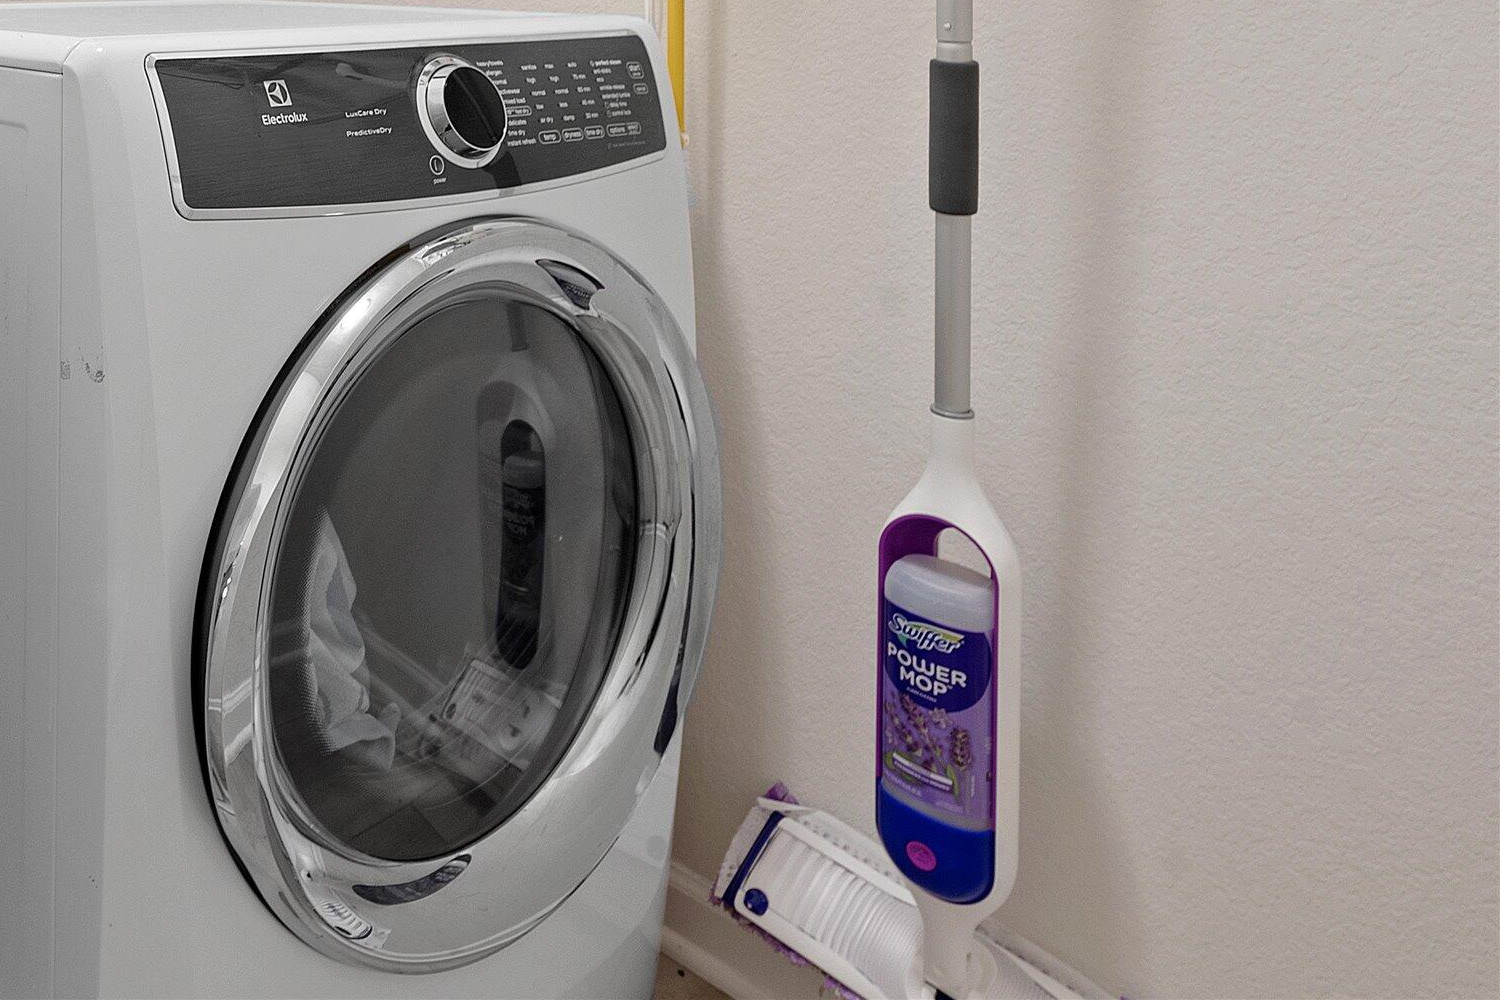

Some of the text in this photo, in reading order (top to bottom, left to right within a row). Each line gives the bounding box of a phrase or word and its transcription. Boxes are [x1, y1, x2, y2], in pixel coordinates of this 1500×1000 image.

[261, 112, 309, 126] Electrolux
[344, 107, 388, 119] LuxCare Dry
[346, 125, 393, 138] PredictiveDry
[433, 176, 447, 185] power
[887, 612, 962, 654] Swiffer
[887, 640, 967, 688] POWER
[899, 665, 948, 696] MOP
